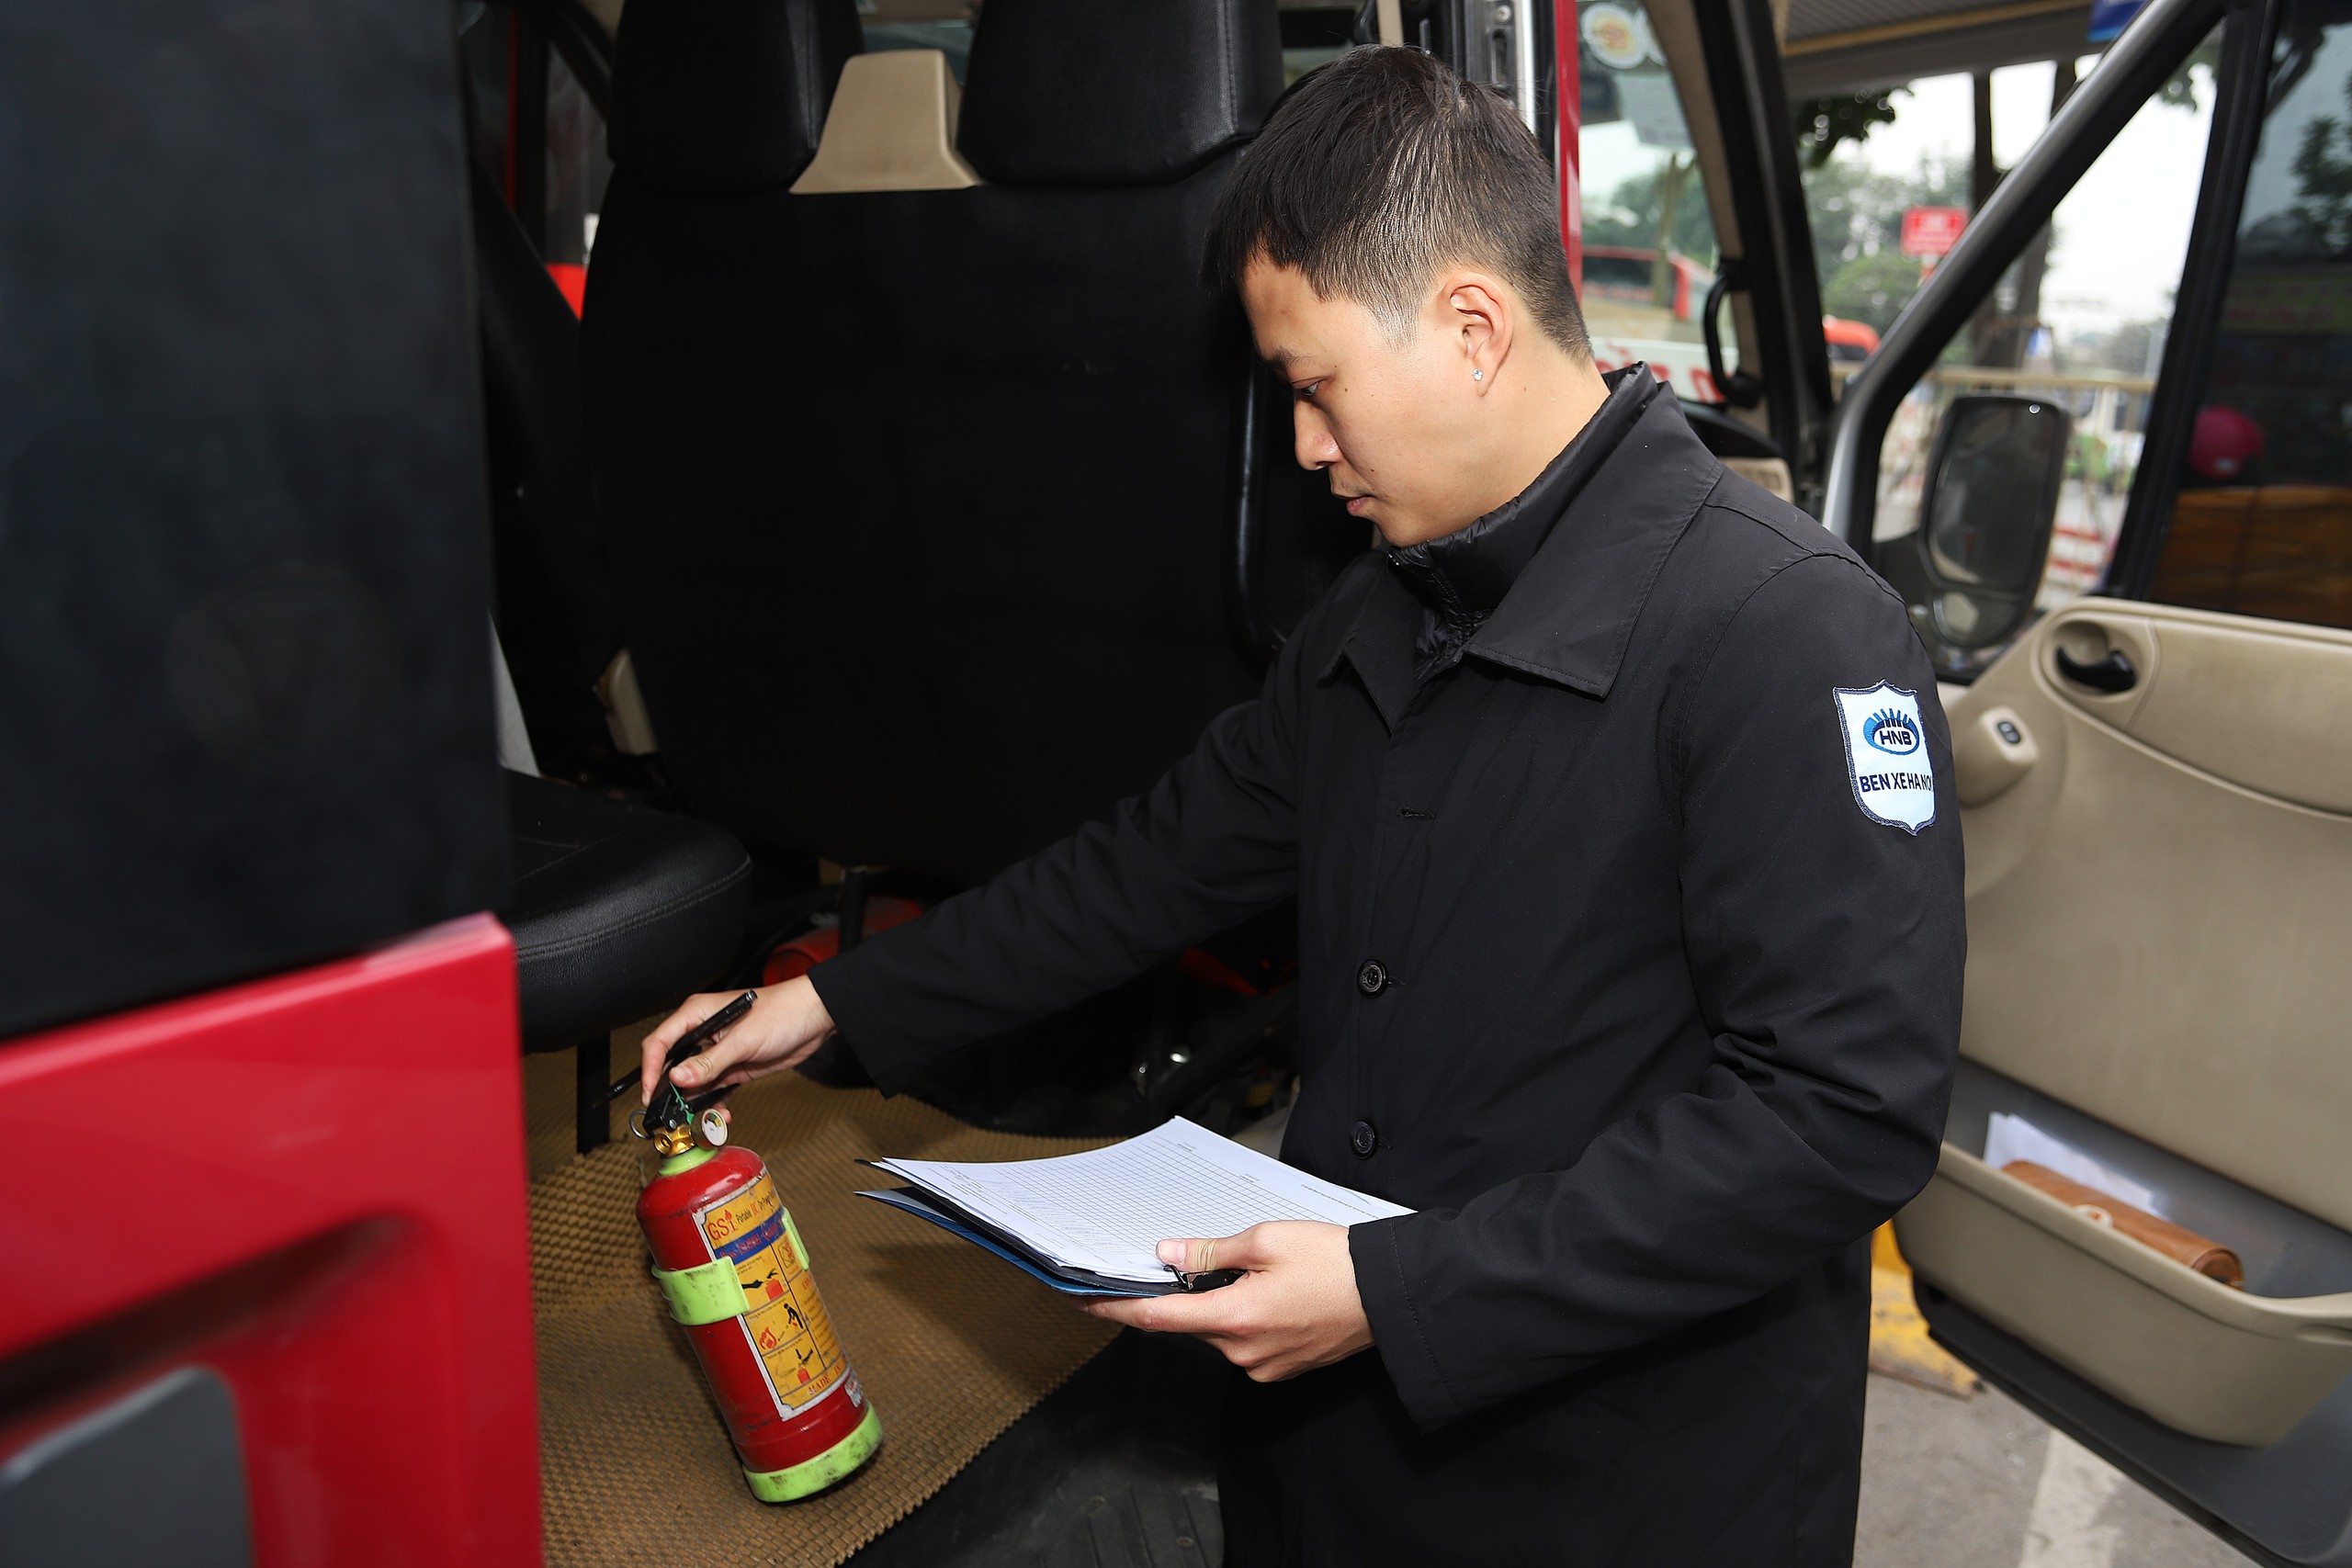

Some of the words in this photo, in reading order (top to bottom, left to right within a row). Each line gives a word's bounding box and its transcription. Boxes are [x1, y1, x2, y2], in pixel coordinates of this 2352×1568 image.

[1879, 730, 1912, 745] HNB
[1859, 773, 1891, 793] BEN
[1891, 773, 1908, 790] XE
[808, 1372, 831, 1395] MADE
